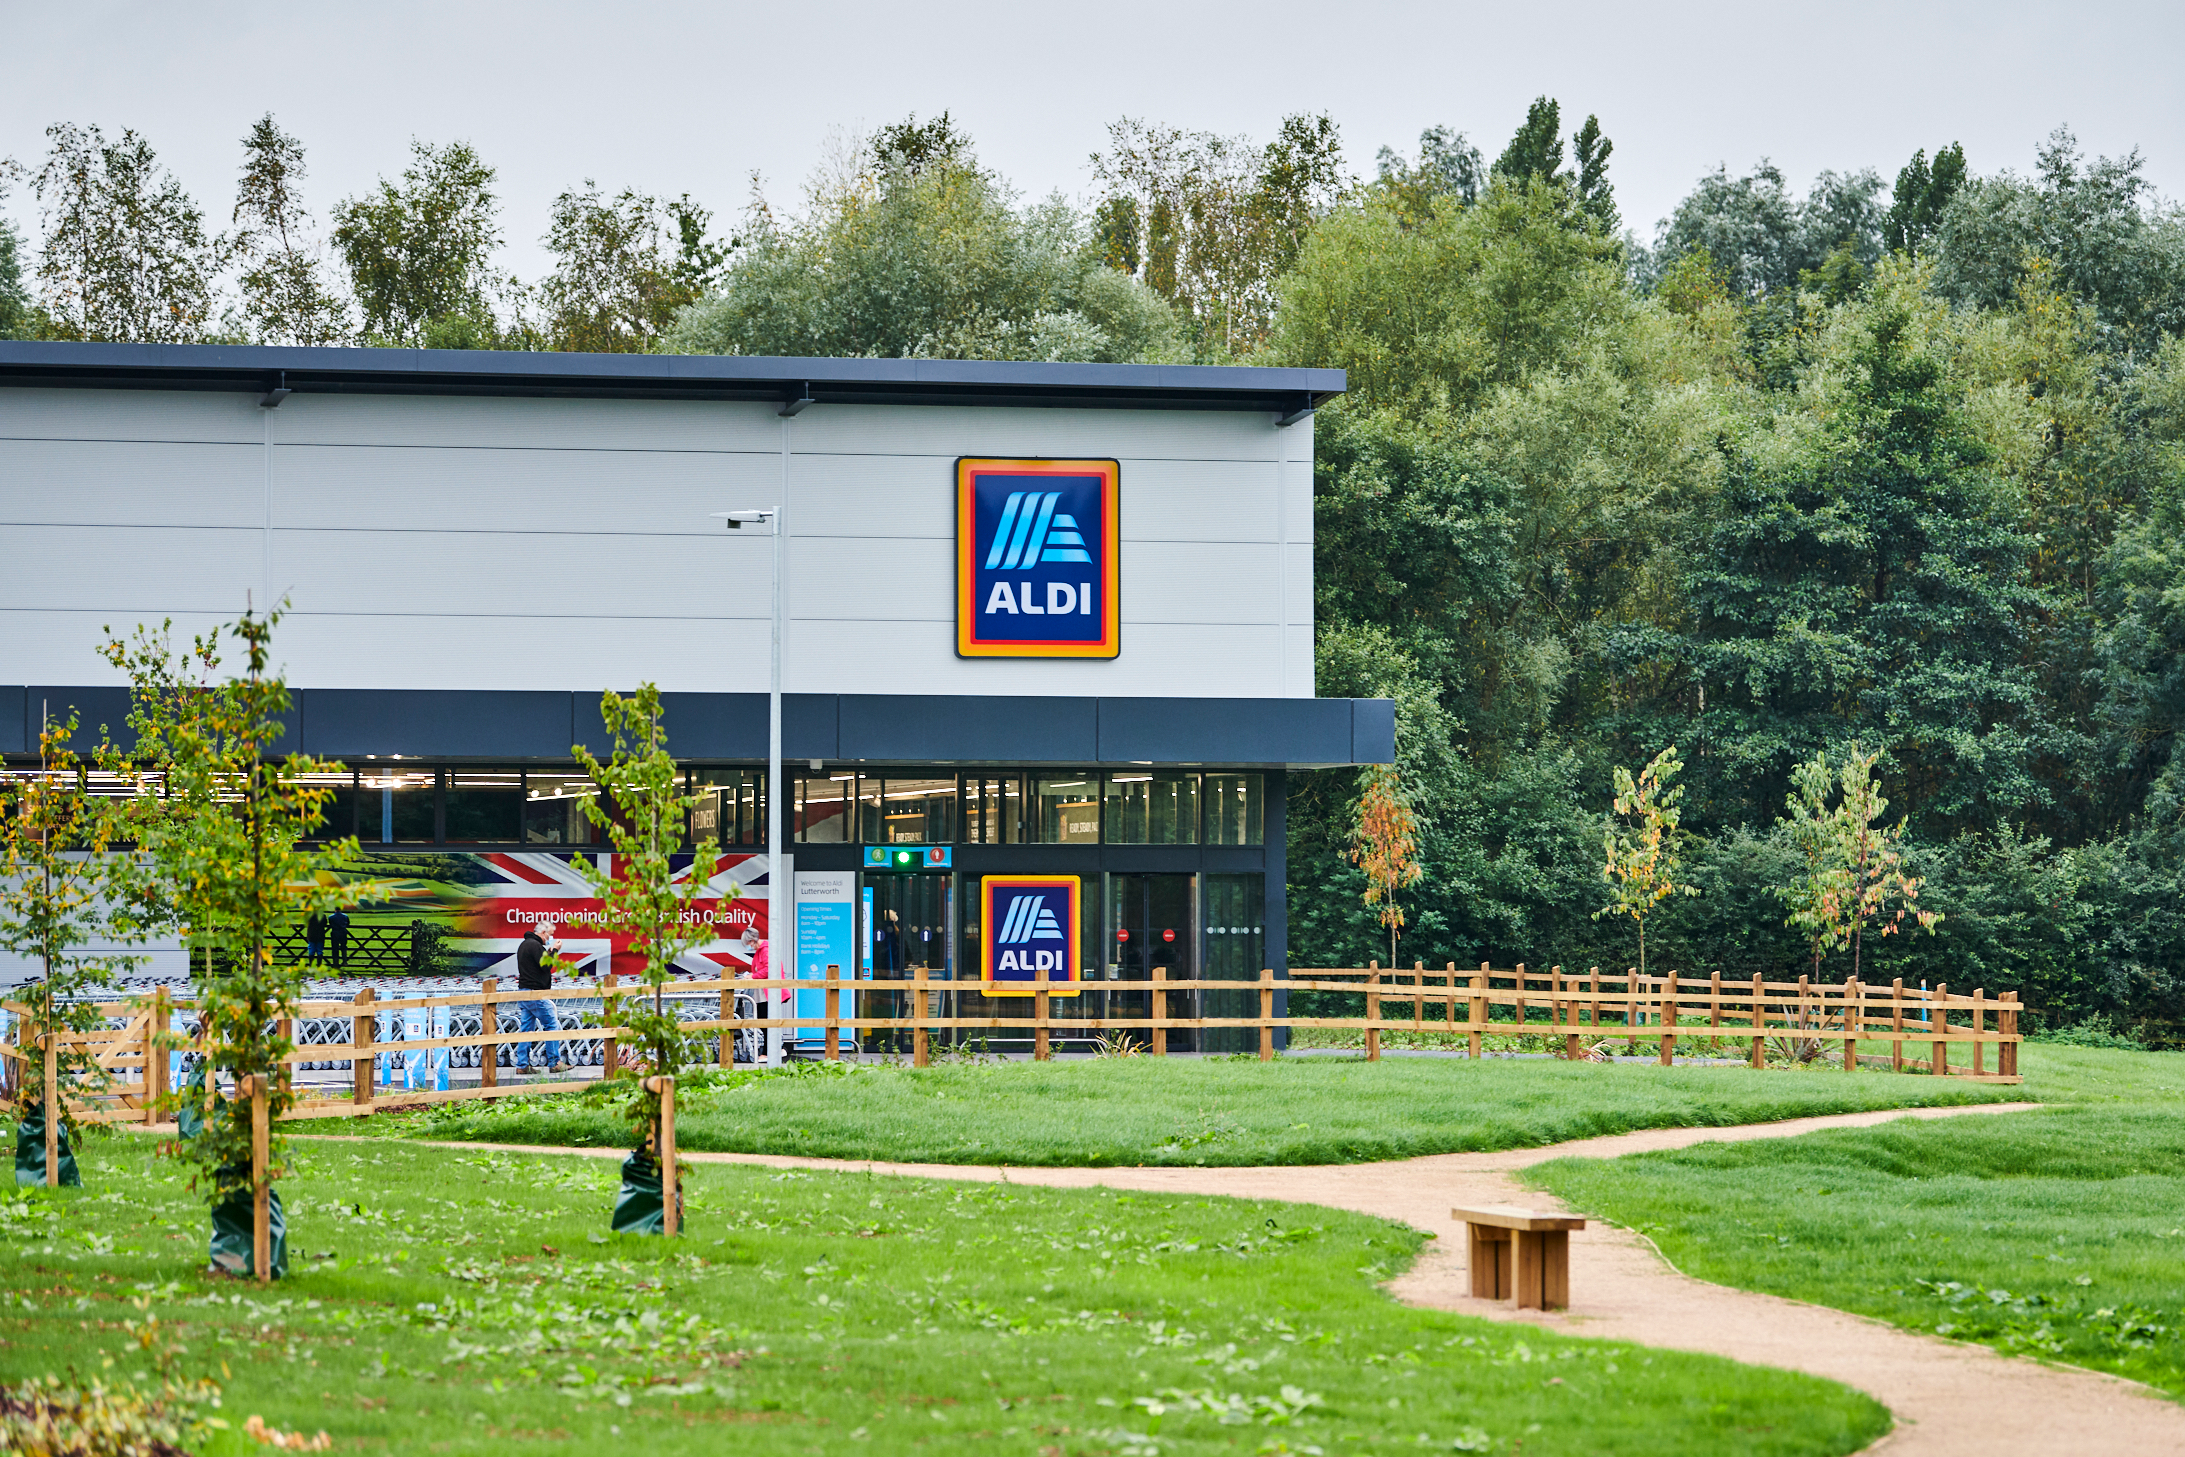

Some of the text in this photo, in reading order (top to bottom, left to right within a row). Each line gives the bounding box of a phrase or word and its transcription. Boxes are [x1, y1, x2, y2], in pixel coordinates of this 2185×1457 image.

[984, 581, 1091, 615] ALDI
[695, 810, 715, 829] FLOWERS
[506, 908, 608, 926] Championing
[703, 908, 756, 927] Quality
[998, 950, 1063, 971] ALDI
